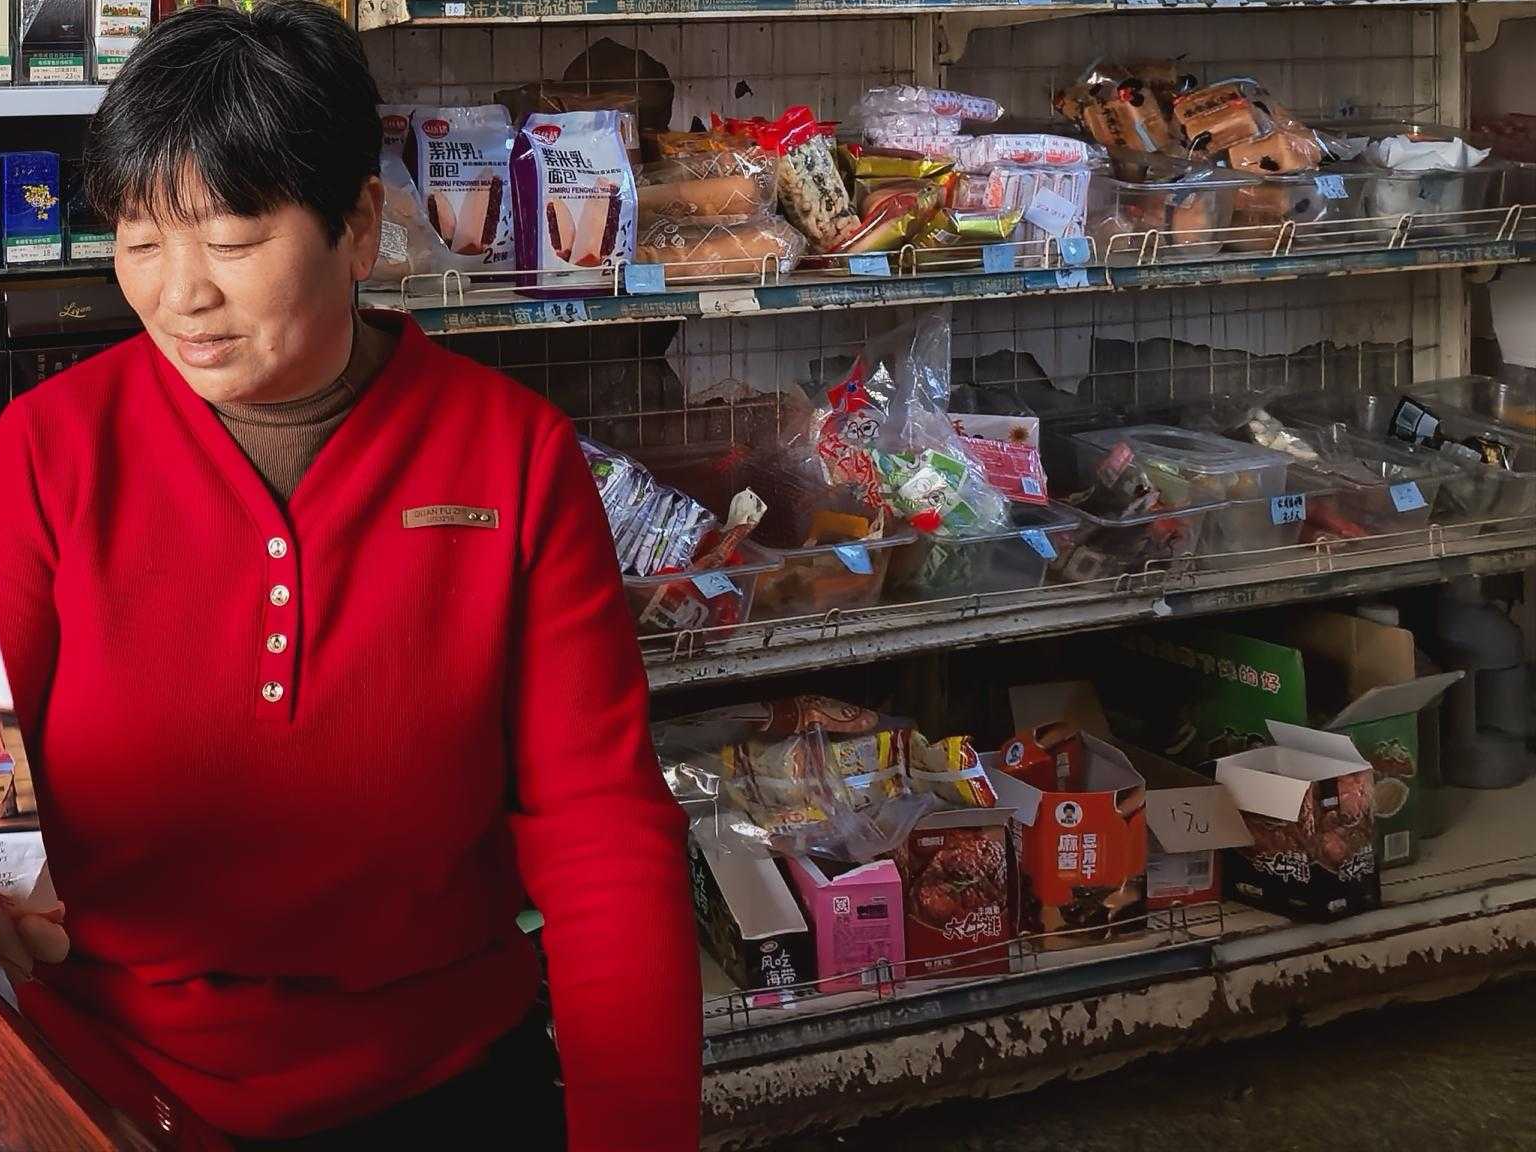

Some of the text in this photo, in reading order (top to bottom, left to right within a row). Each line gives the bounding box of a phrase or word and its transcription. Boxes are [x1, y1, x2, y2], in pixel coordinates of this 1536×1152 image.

[428, 141, 475, 160] 紫米乳
[541, 148, 587, 168] 紫米乳
[429, 162, 459, 178] 面包
[548, 168, 577, 184] 面包
[58, 302, 93, 319] Liqun
[942, 913, 1002, 943] 大牛排
[760, 952, 791, 971] 风吃
[765, 969, 797, 987] 海带
